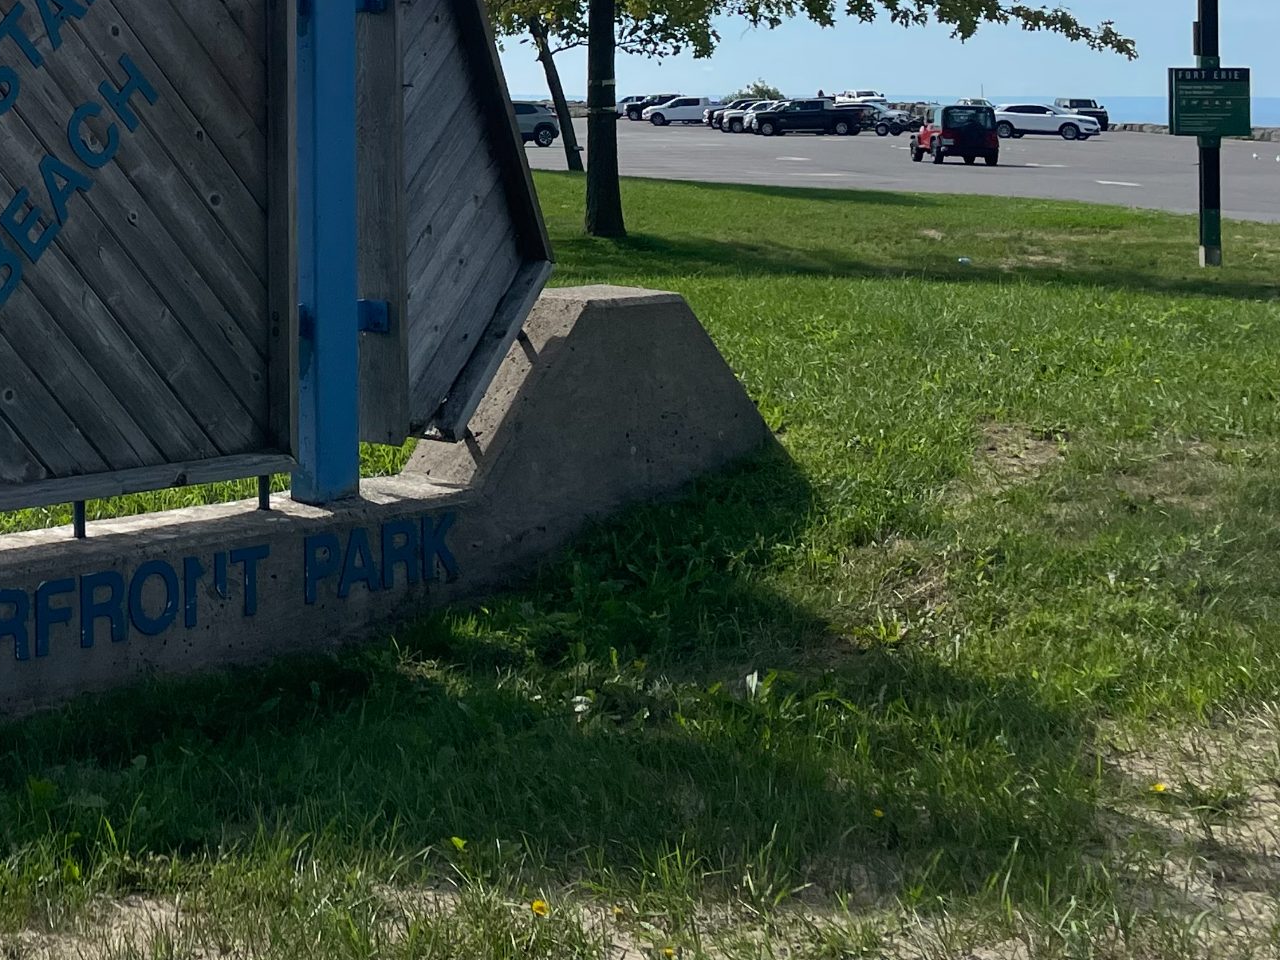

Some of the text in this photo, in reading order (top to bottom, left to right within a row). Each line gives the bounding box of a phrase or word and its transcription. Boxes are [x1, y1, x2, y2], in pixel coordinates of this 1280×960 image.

[1178, 70, 1240, 79] FORT ERIE
[304, 512, 459, 605] PARK
